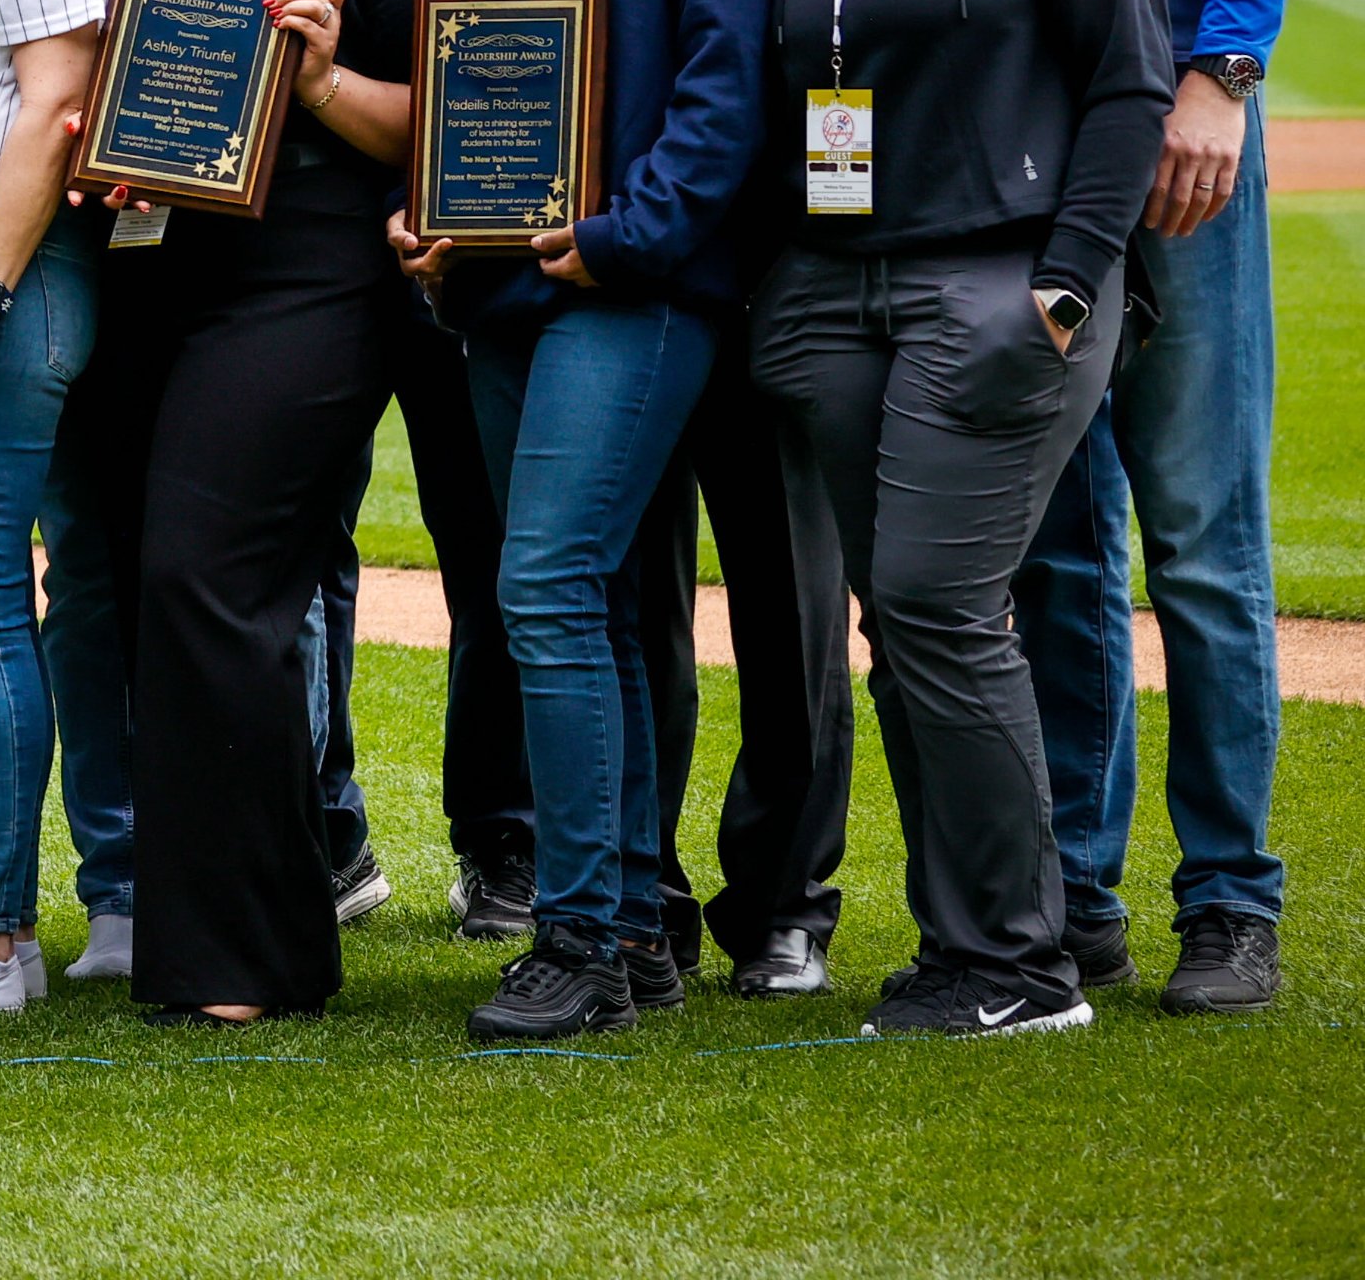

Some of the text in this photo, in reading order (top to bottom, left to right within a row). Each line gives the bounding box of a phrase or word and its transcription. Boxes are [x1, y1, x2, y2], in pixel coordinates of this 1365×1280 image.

[215, 2, 254, 16] AWARD
[142, 38, 236, 63] Ashley Triunfel
[458, 51, 556, 61] LEADERSHIP AWARD
[132, 55, 145, 65] For
[145, 58, 169, 70] being
[176, 63, 203, 76] shining
[203, 68, 238, 80] example
[151, 69, 214, 86] of leadership for
[141, 77, 175, 89] students
[174, 82, 183, 90] in
[183, 83, 197, 93] the
[197, 85, 220, 96] Bronx
[139, 93, 218, 112] The New York Yankees
[446, 98, 551, 113] Yadeilis Rodriguez
[447, 119, 460, 128] For
[460, 119, 483, 129] being
[491, 119, 517, 128] shining
[824, 151, 852, 160] GUEST
